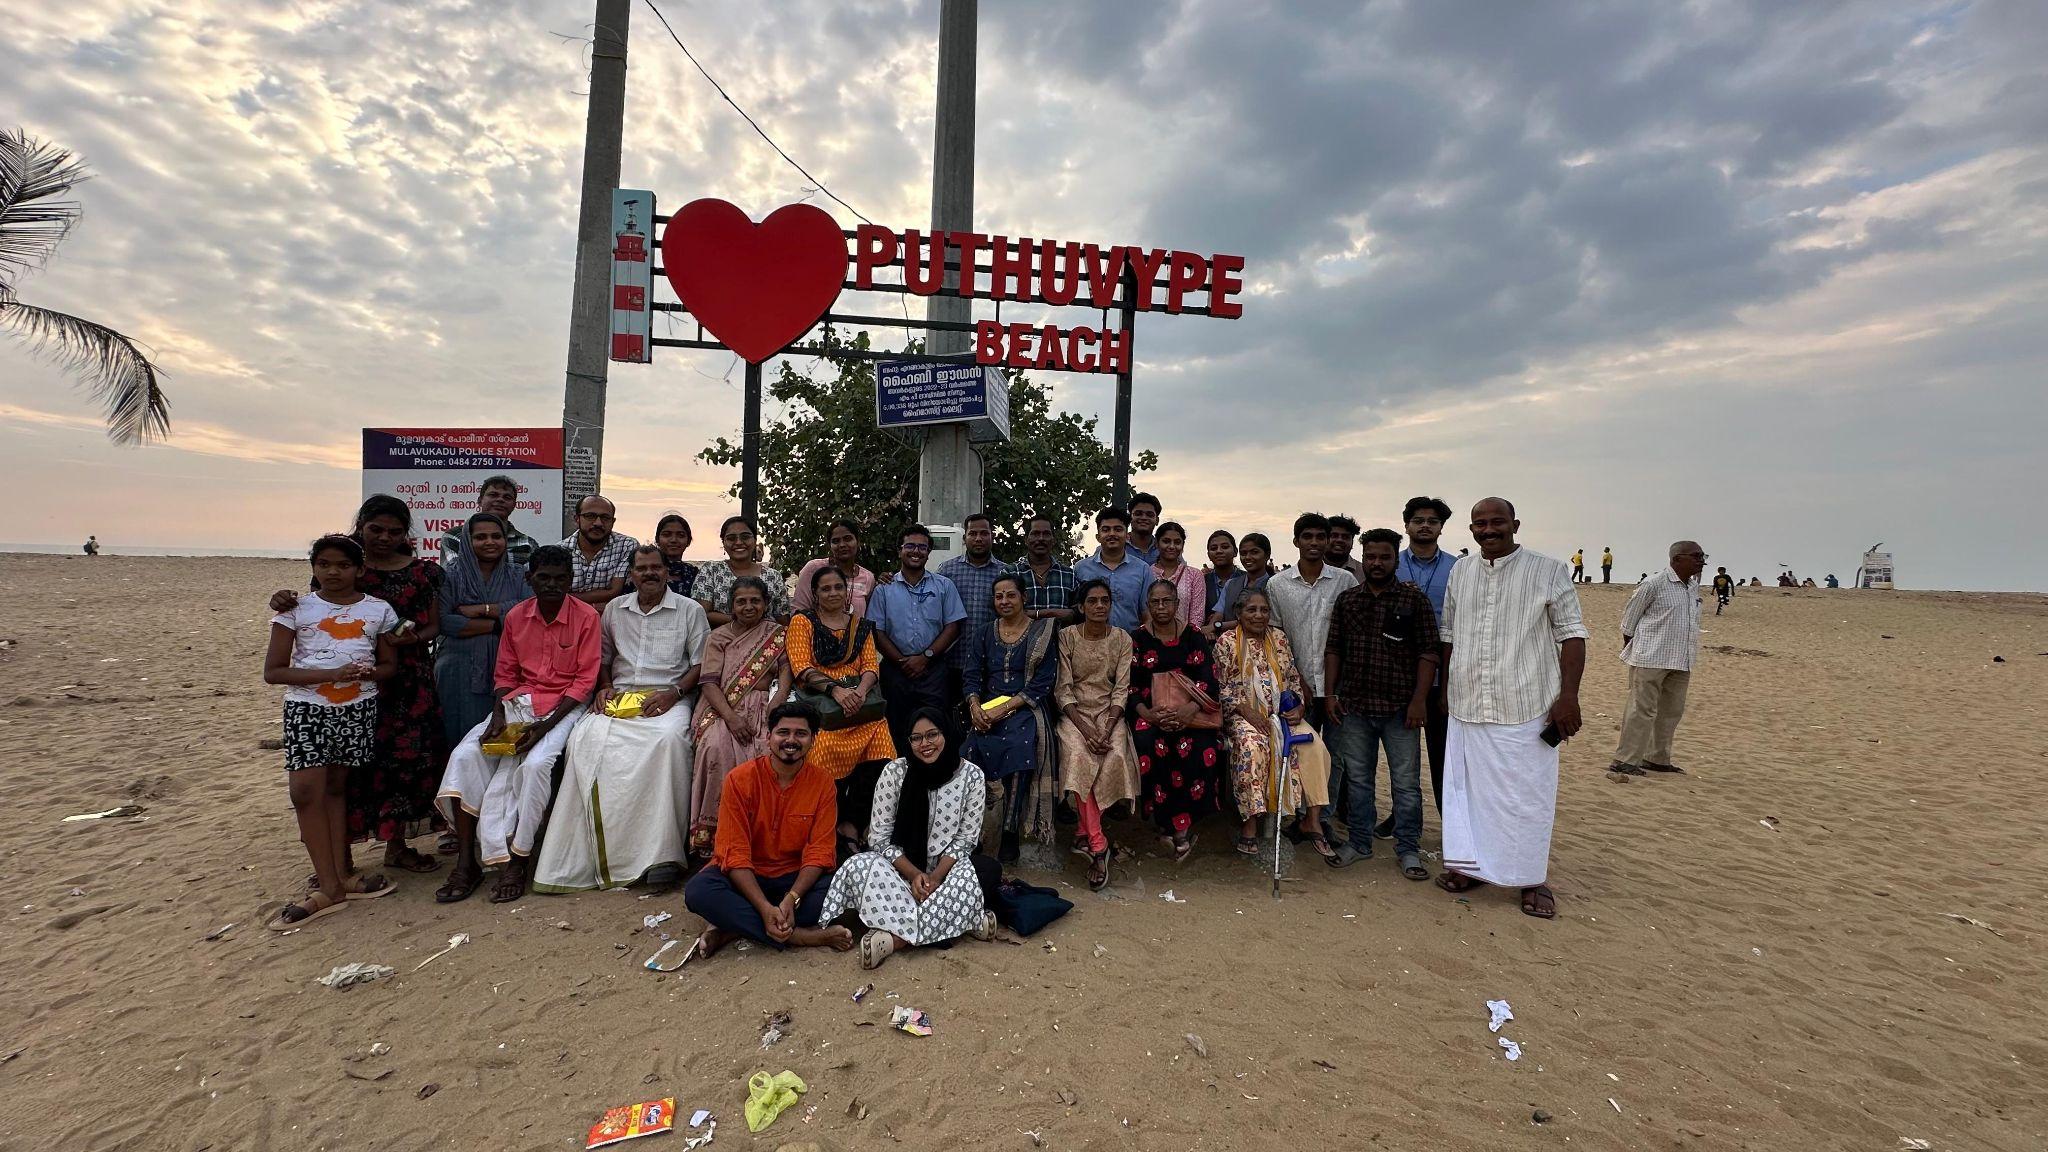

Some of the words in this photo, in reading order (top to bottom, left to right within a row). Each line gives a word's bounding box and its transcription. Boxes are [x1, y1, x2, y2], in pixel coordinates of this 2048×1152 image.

[856, 224, 1246, 319] PUTHUVYPE
[976, 320, 1130, 374] BEACH
[936, 365, 982, 384] ഈഡൻ
[395, 434, 447, 446] മുളവുകാട്
[389, 448, 456, 456] MULAVUKADU
[458, 448, 494, 456] POLICE
[496, 448, 536, 456] STATION
[414, 458, 446, 466] Phone:
[448, 458, 470, 466] 0484
[472, 458, 493, 466] 2750
[496, 458, 512, 466] 772
[396, 481, 430, 496] രാത്രി
[436, 484, 448, 493] 10
